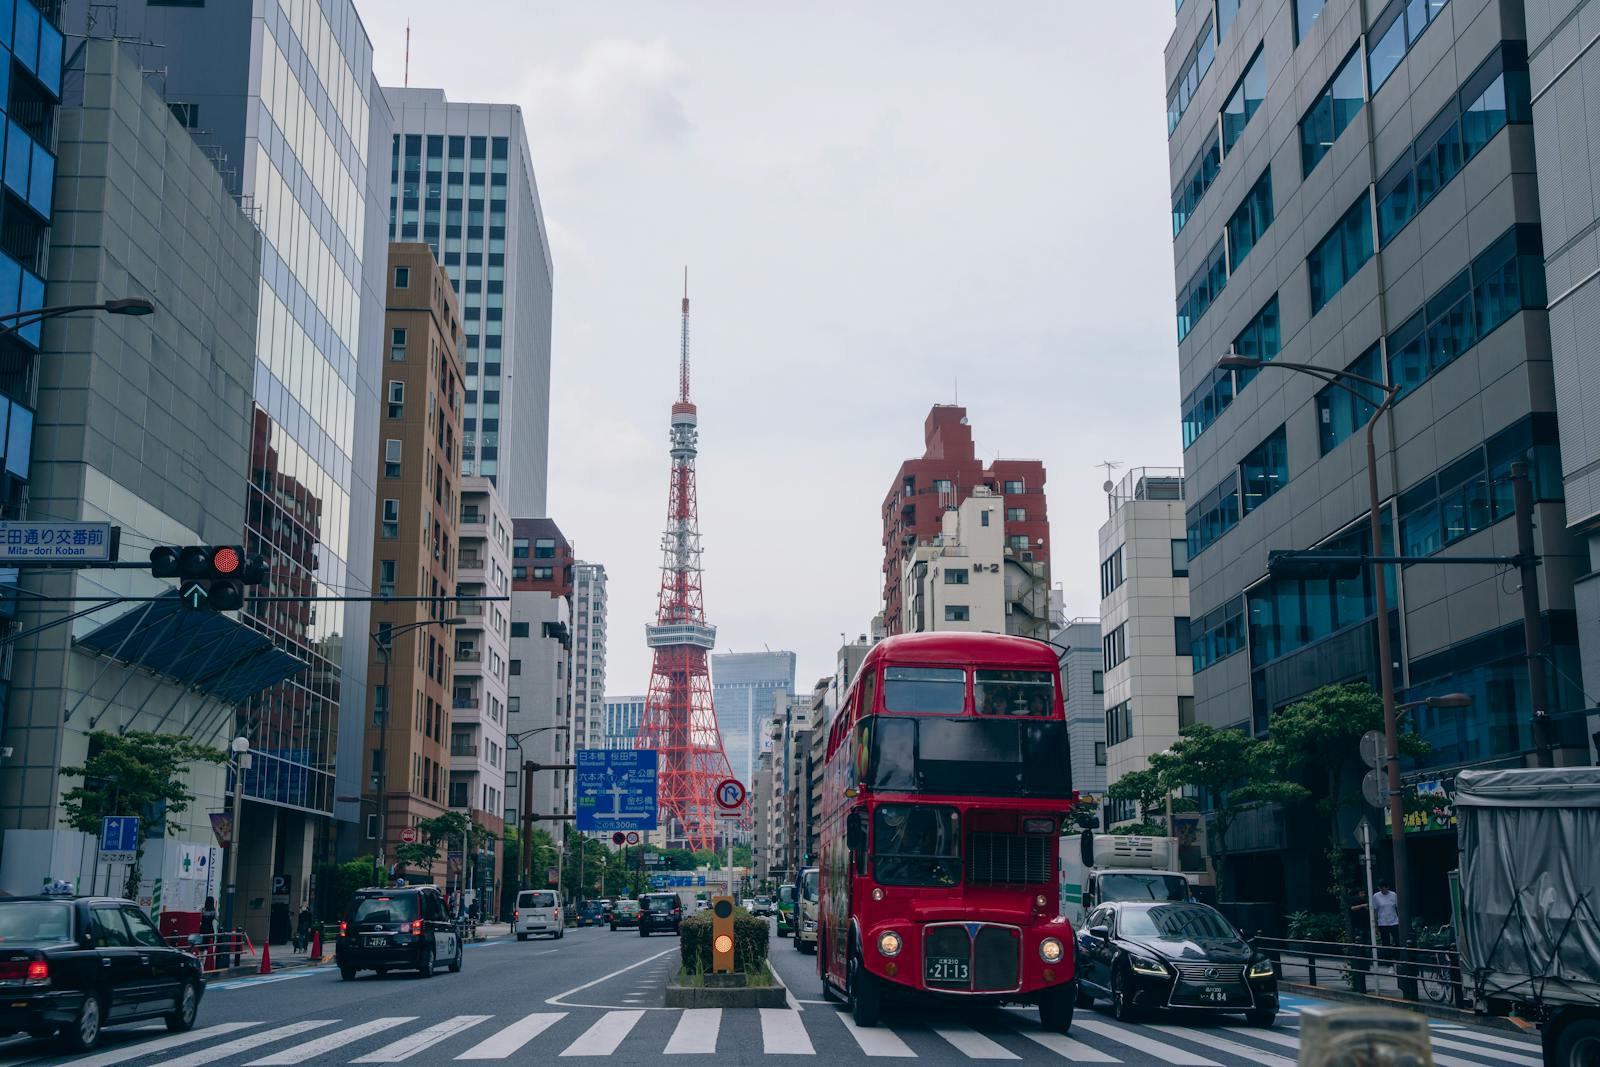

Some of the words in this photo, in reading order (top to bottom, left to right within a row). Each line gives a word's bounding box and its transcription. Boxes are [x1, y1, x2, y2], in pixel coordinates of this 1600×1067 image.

[8, 546, 52, 555] Mita-dori
[55, 546, 85, 555] Koban
[973, 563, 999, 573] M-2
[579, 773, 606, 781] 六本木
[101, 854, 134, 862] ここから
[934, 964, 968, 978] 21-13
